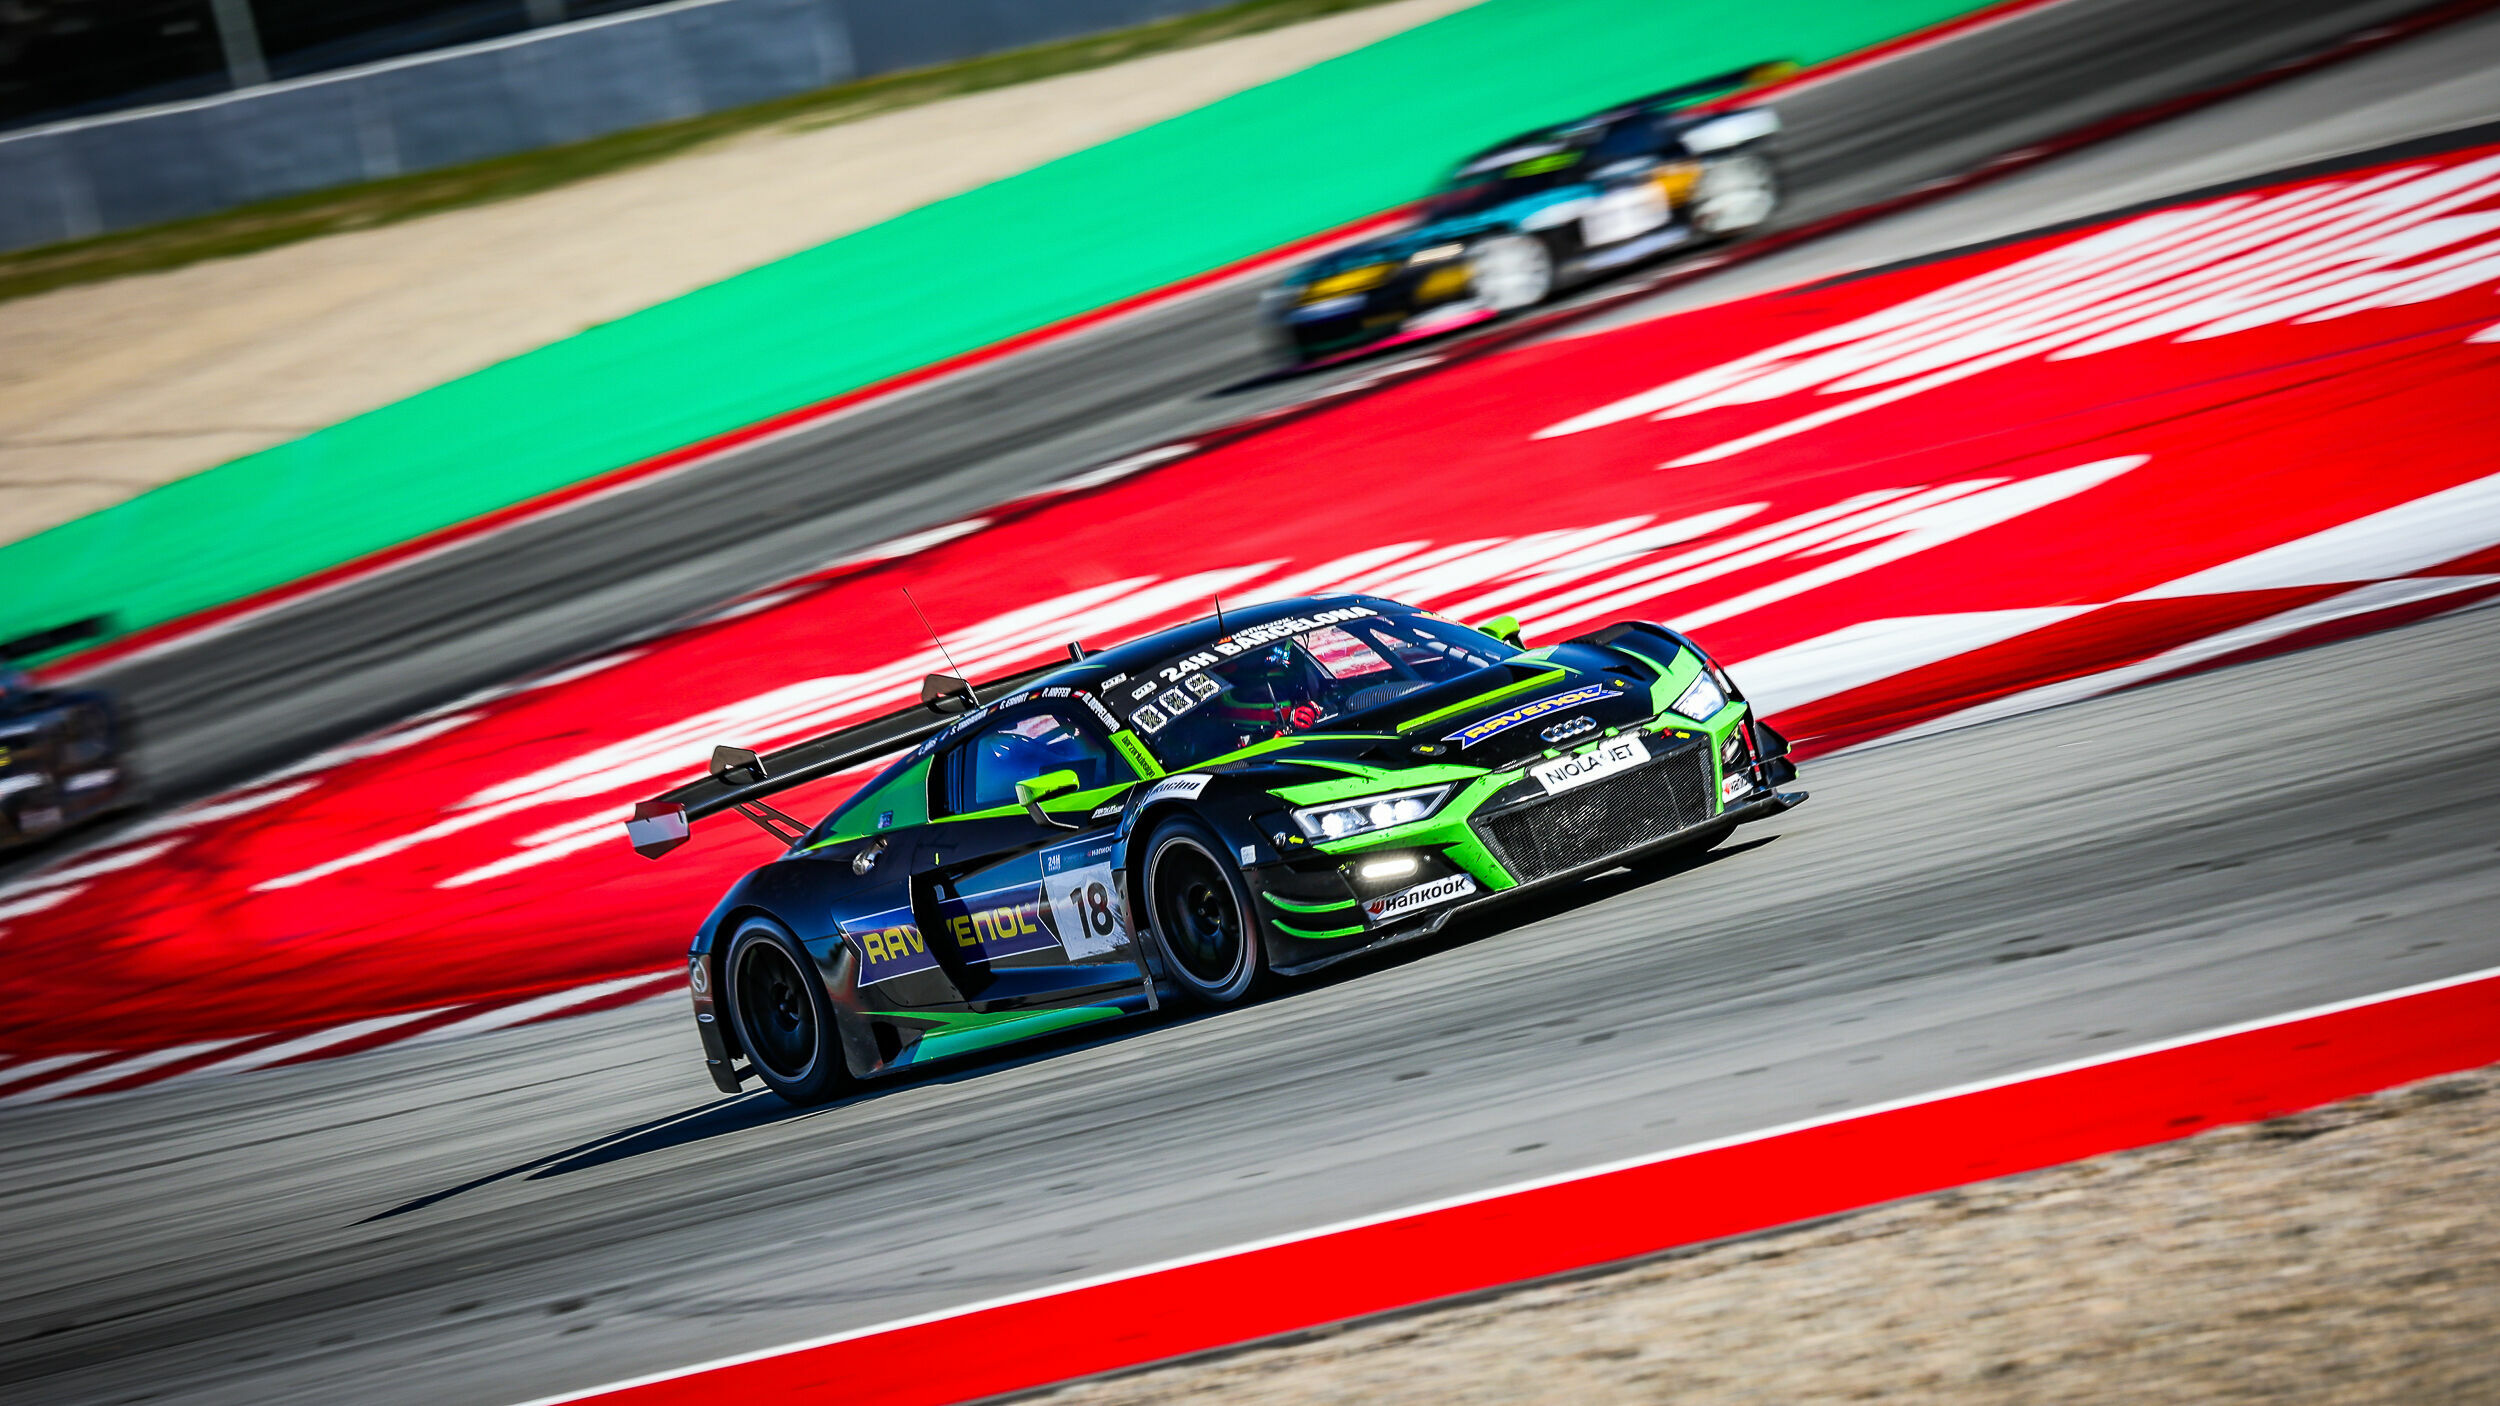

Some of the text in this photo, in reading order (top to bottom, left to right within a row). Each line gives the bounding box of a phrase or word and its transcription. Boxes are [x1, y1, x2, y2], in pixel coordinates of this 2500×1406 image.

[1160, 652, 1219, 682] 24H
[1214, 606, 1378, 656] BARCELONA
[1464, 690, 1601, 739] RAVENOL
[862, 904, 1037, 965] RAVENOL
[1069, 882, 1115, 939] 18
